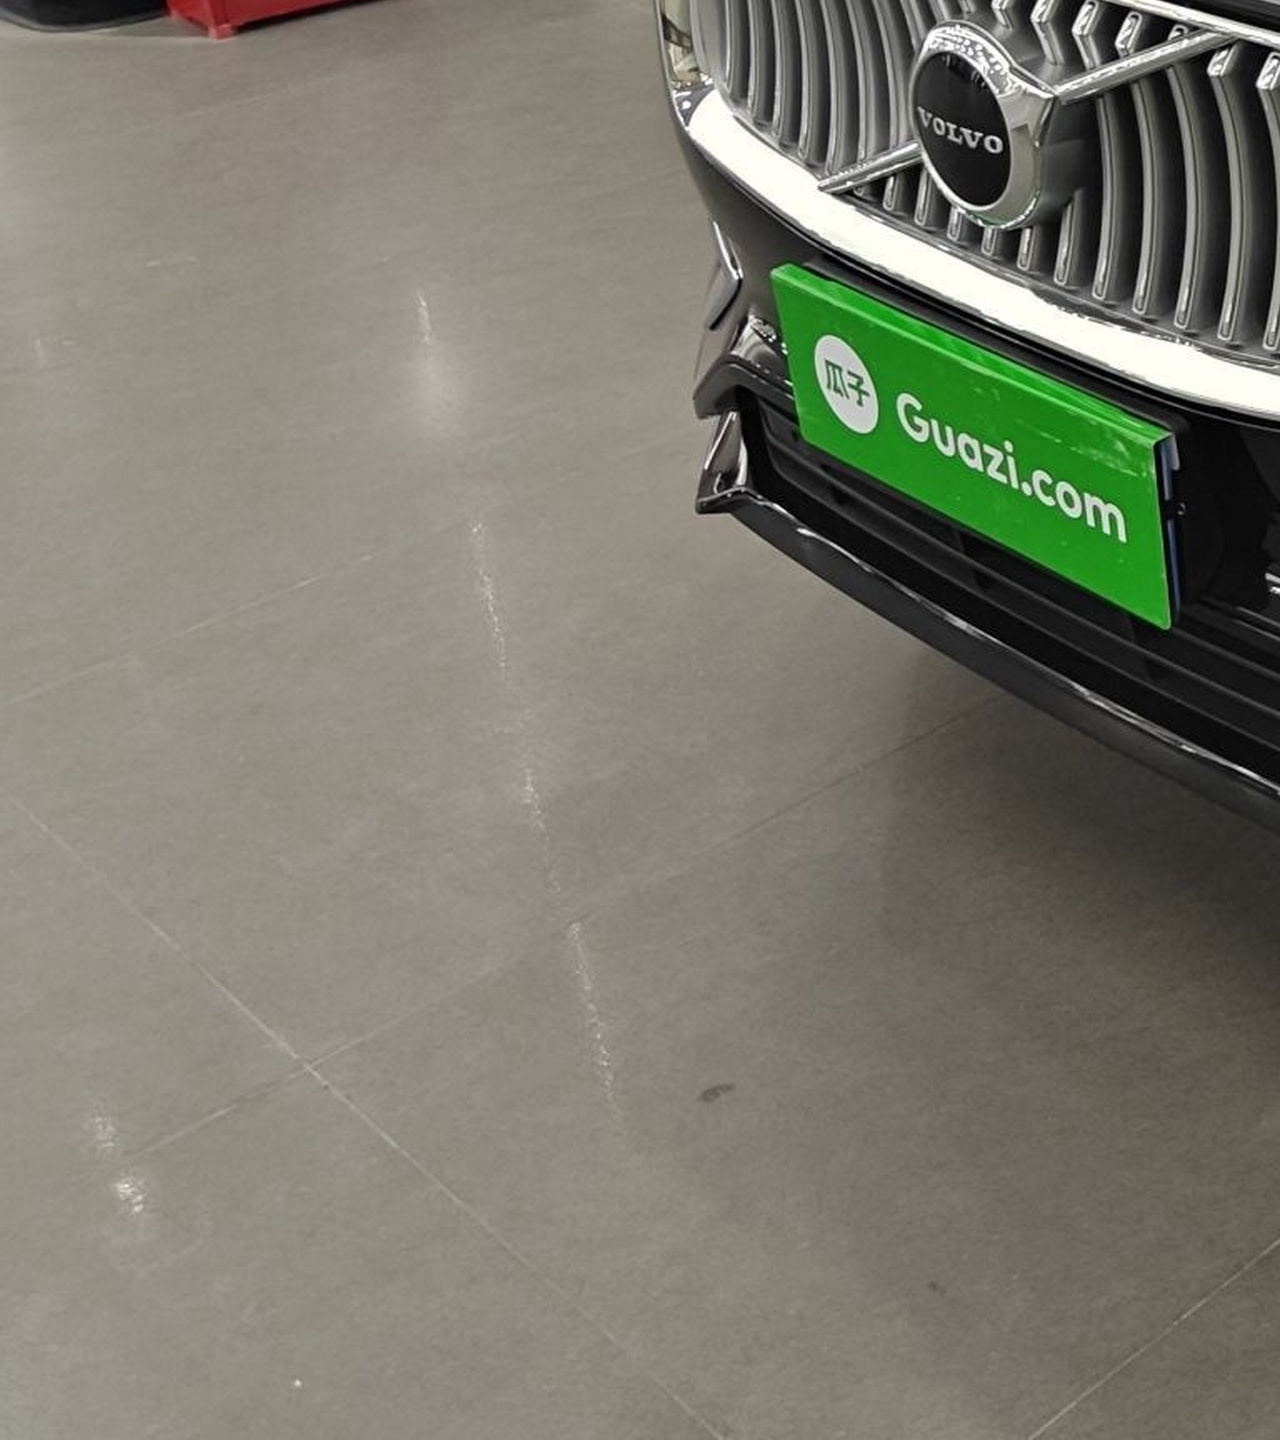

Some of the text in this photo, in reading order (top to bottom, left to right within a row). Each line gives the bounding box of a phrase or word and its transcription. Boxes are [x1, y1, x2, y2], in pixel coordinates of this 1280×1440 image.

[917, 106, 1003, 155] VOLVO
[823, 358, 871, 408] 瓜子
[896, 392, 1128, 545] Guazi.com
